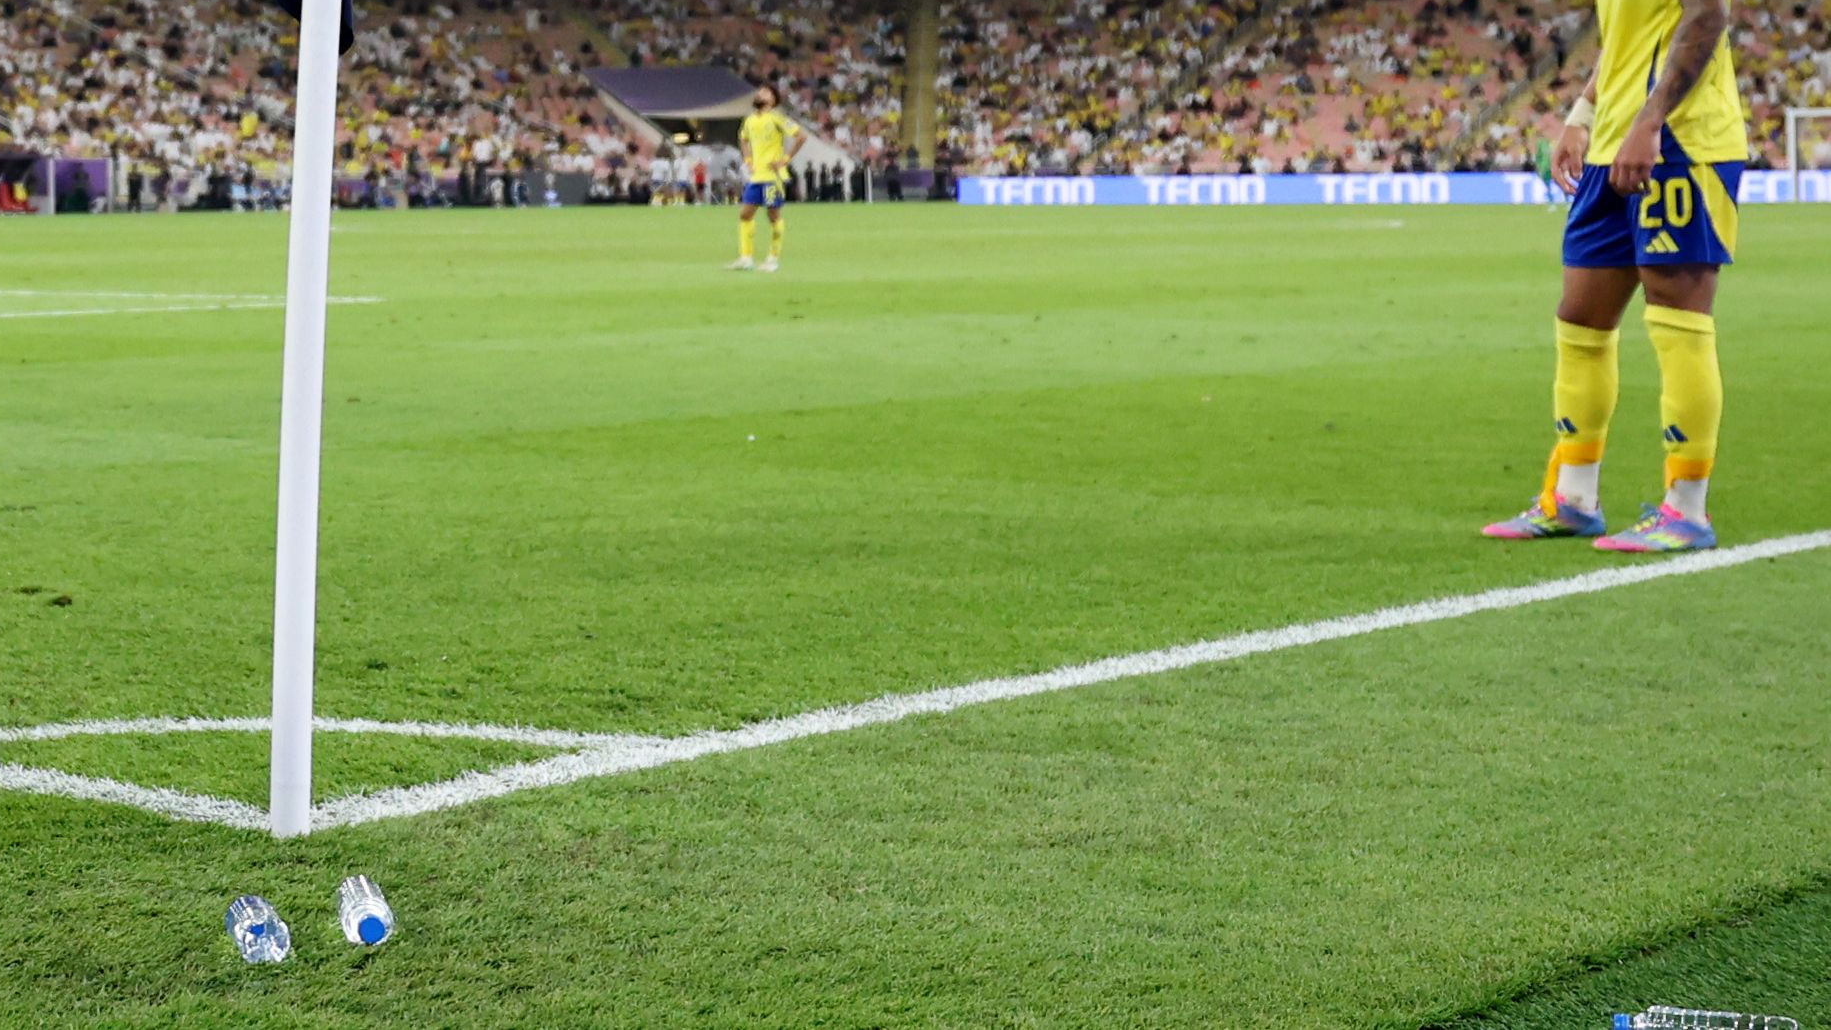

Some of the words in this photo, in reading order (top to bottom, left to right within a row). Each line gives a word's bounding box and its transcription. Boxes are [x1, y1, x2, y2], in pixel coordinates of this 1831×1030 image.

[1143, 174, 1267, 204] TECNO
[1314, 173, 1451, 204] TECNO
[1638, 177, 1693, 228] 20
